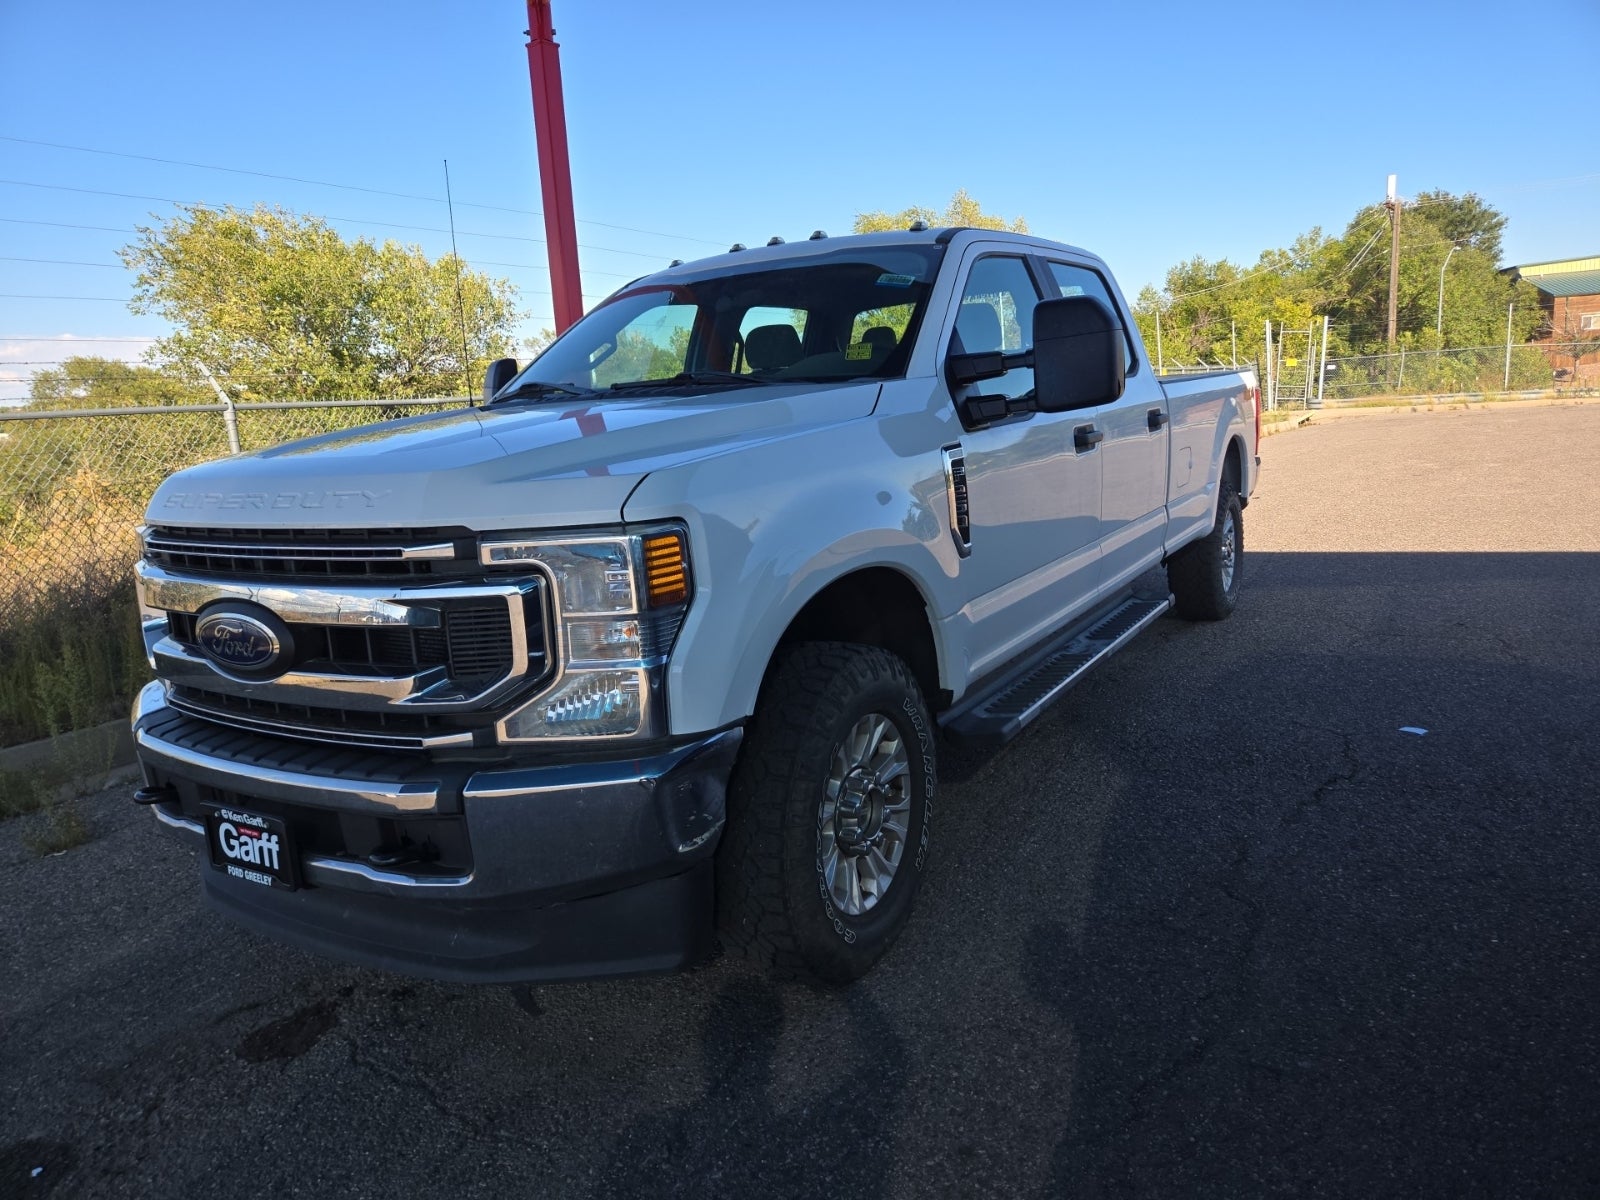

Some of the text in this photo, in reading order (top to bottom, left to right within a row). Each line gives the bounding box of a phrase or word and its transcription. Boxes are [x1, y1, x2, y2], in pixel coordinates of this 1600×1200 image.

[164, 490, 392, 509] SUPER DUTY
[212, 624, 256, 658] Ford
[902, 697, 934, 872] WRANGLER
[219, 822, 280, 870] Garff
[227, 865, 272, 886] FORD GREELEY
